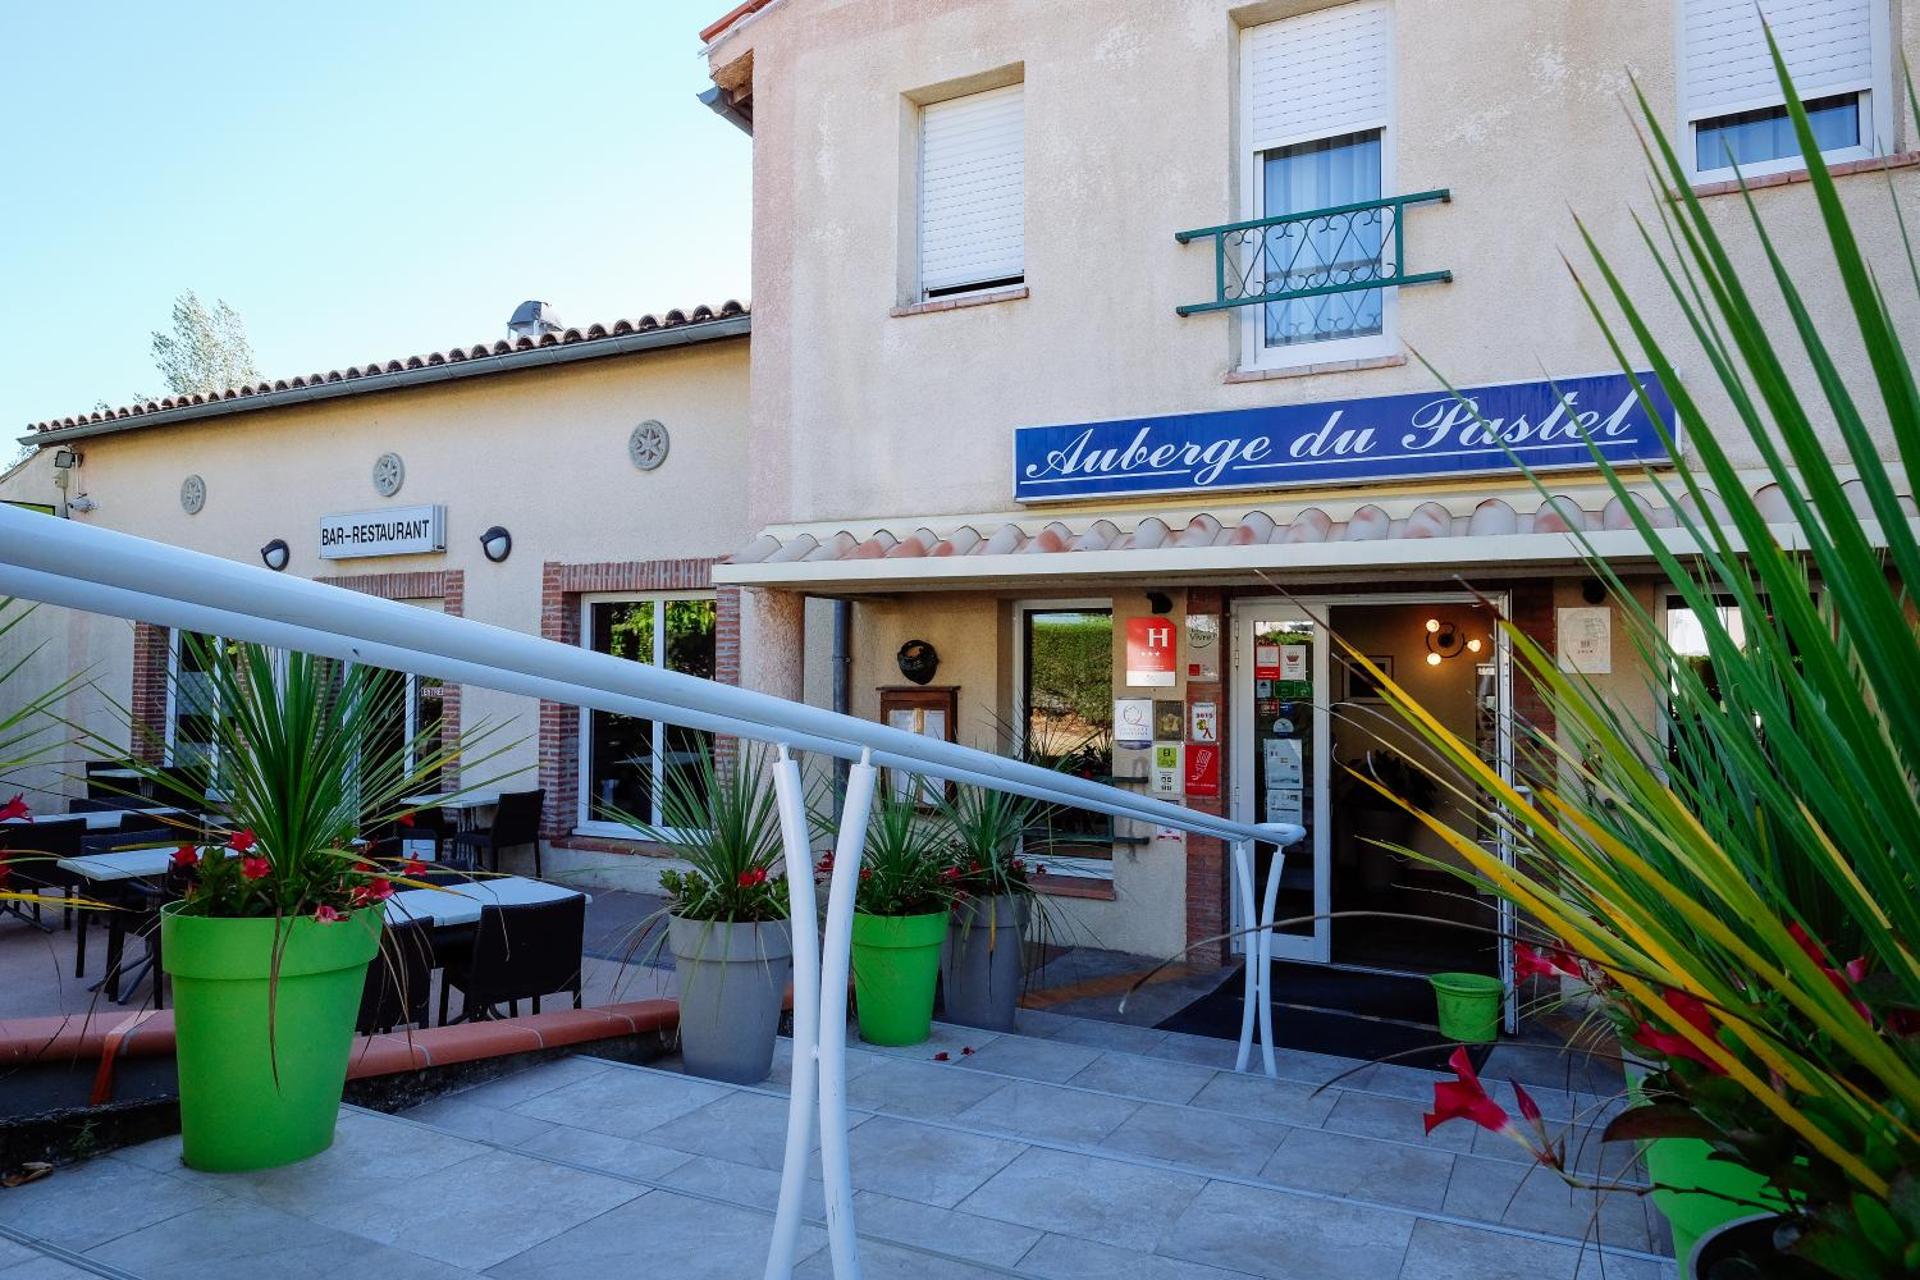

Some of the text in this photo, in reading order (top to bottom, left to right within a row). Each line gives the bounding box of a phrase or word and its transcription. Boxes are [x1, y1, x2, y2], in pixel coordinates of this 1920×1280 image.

[1026, 383, 1646, 486] Auberge du Pastel
[322, 520, 430, 546] BAR-RESTAURANT
[1146, 627, 1171, 648] H
